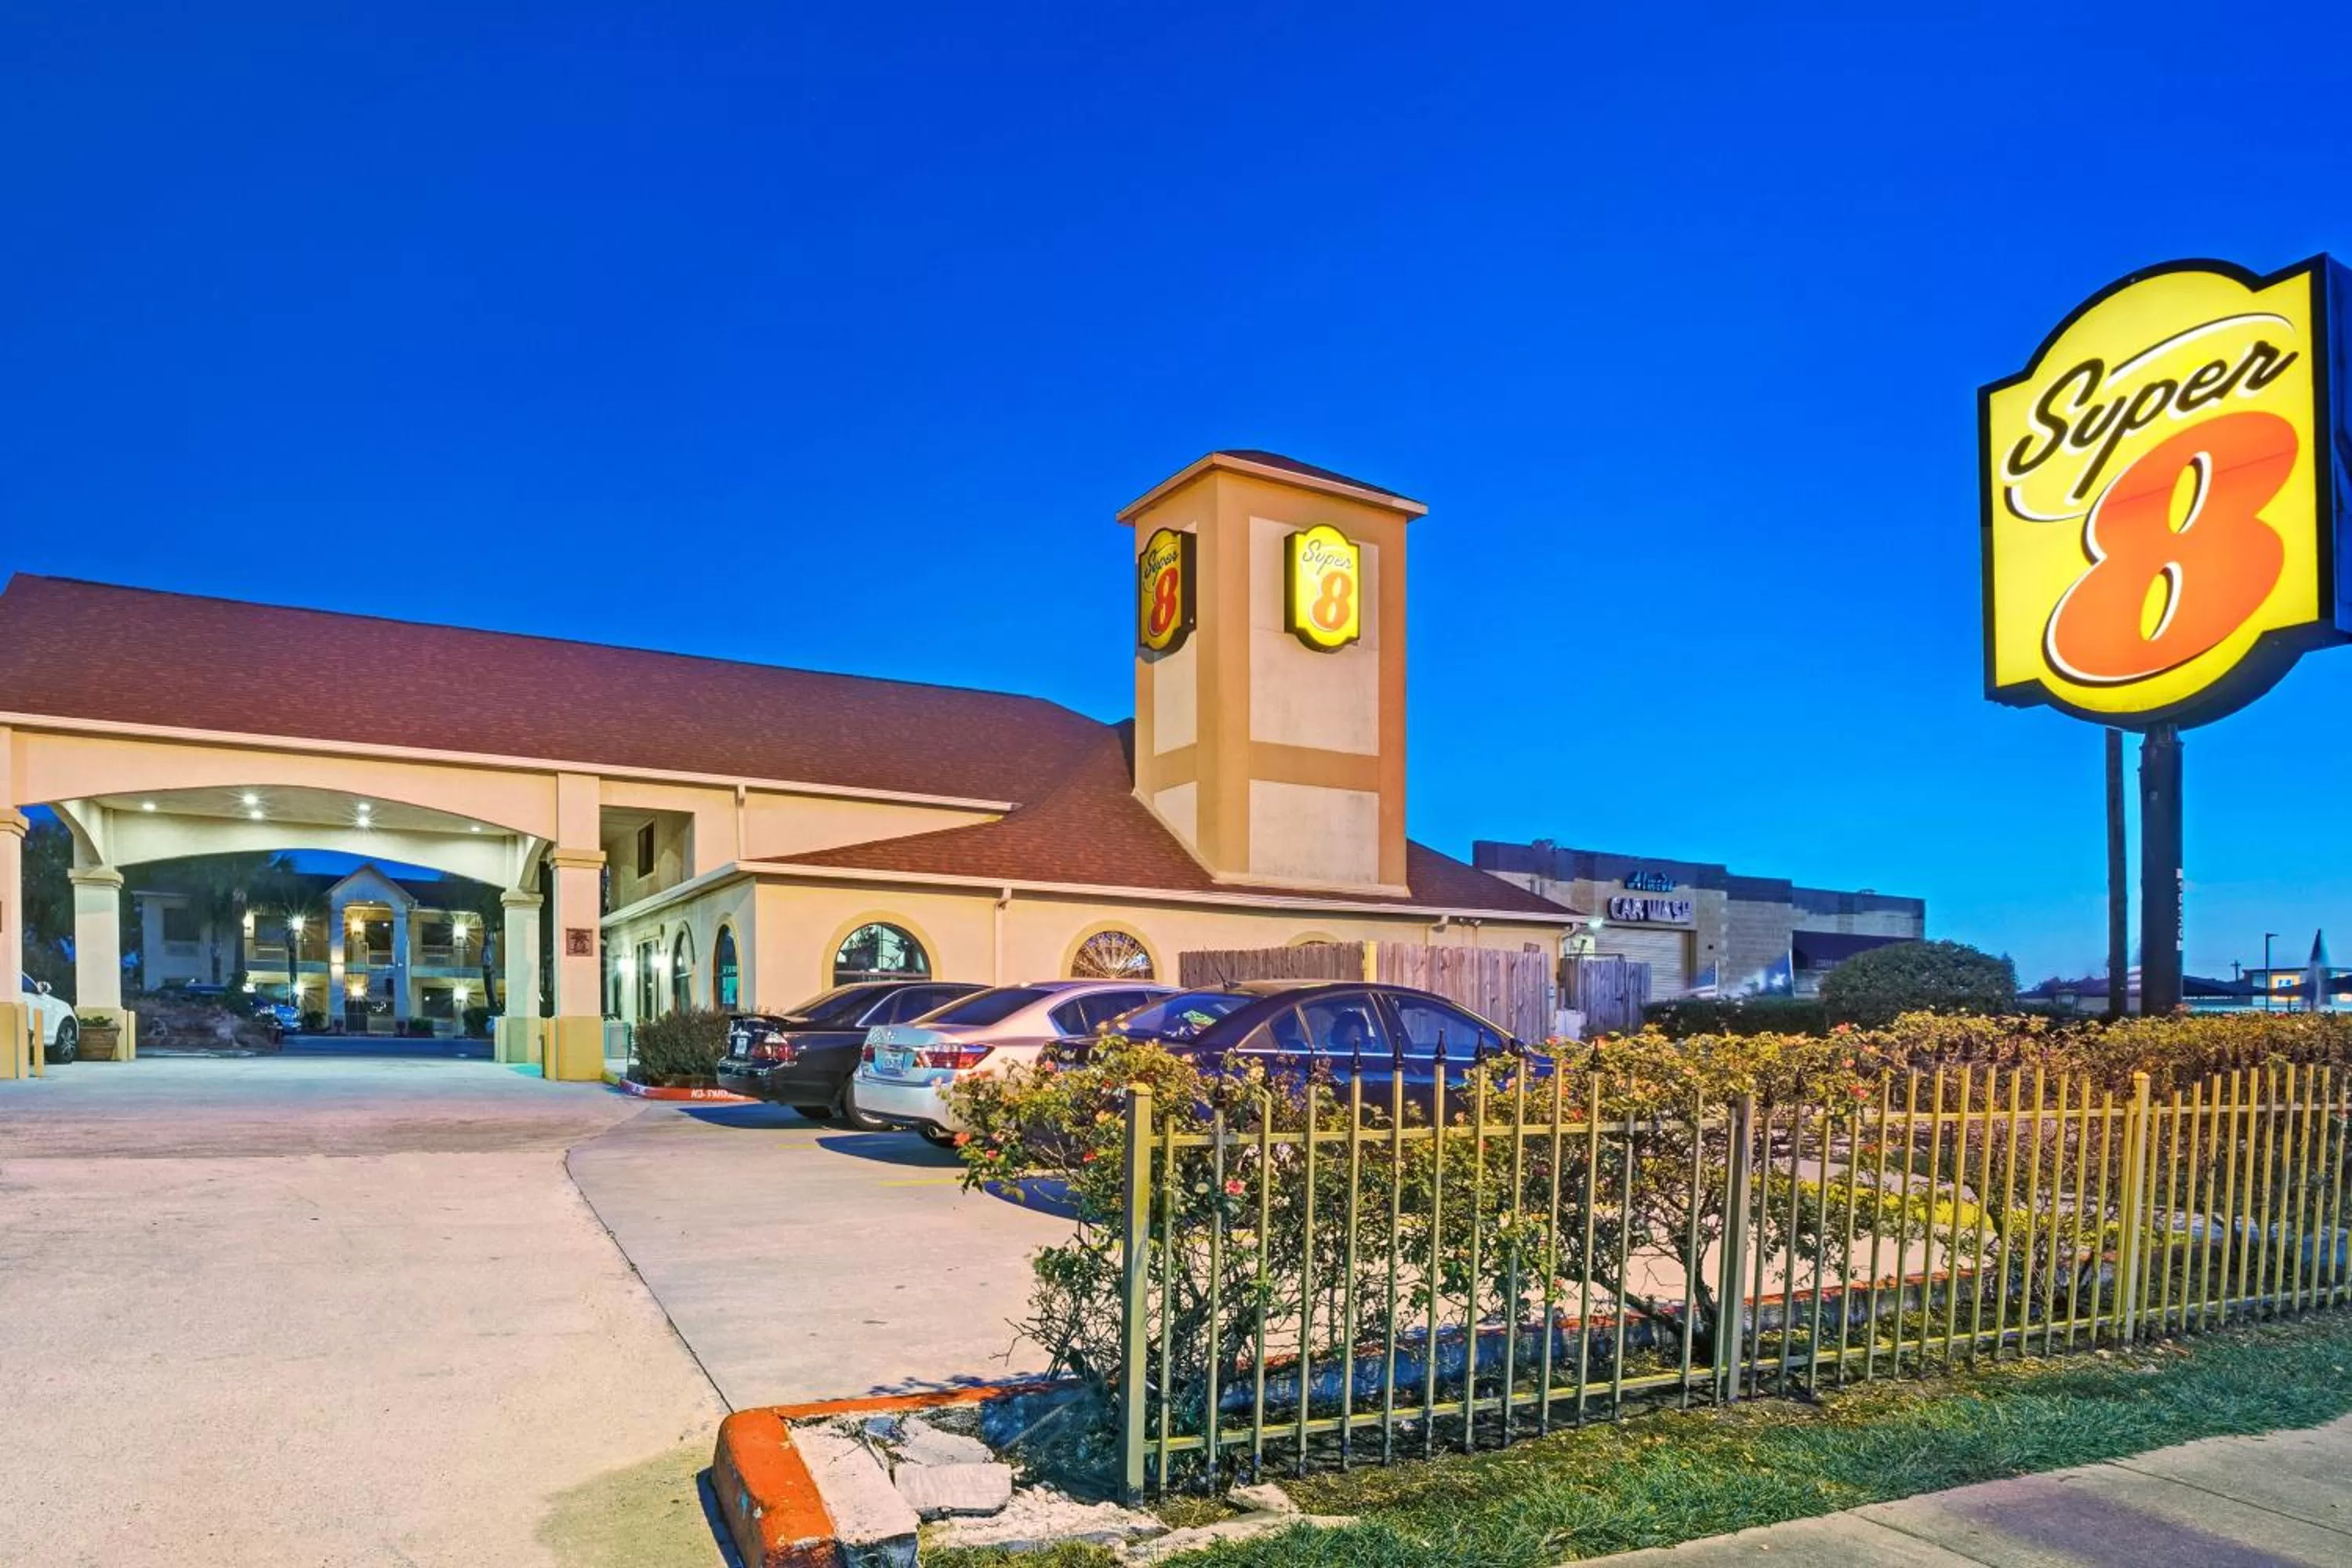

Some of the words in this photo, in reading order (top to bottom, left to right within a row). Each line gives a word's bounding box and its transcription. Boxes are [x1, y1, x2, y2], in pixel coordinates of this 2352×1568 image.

[2005, 339, 2299, 504] Super
[1302, 539, 1353, 575] Super
[2042, 410, 2299, 688] 8
[1149, 567, 1178, 637] 8
[1308, 571, 1352, 632] 8
[1610, 896, 1645, 921] CAR
[1647, 899, 1692, 923] WASH
